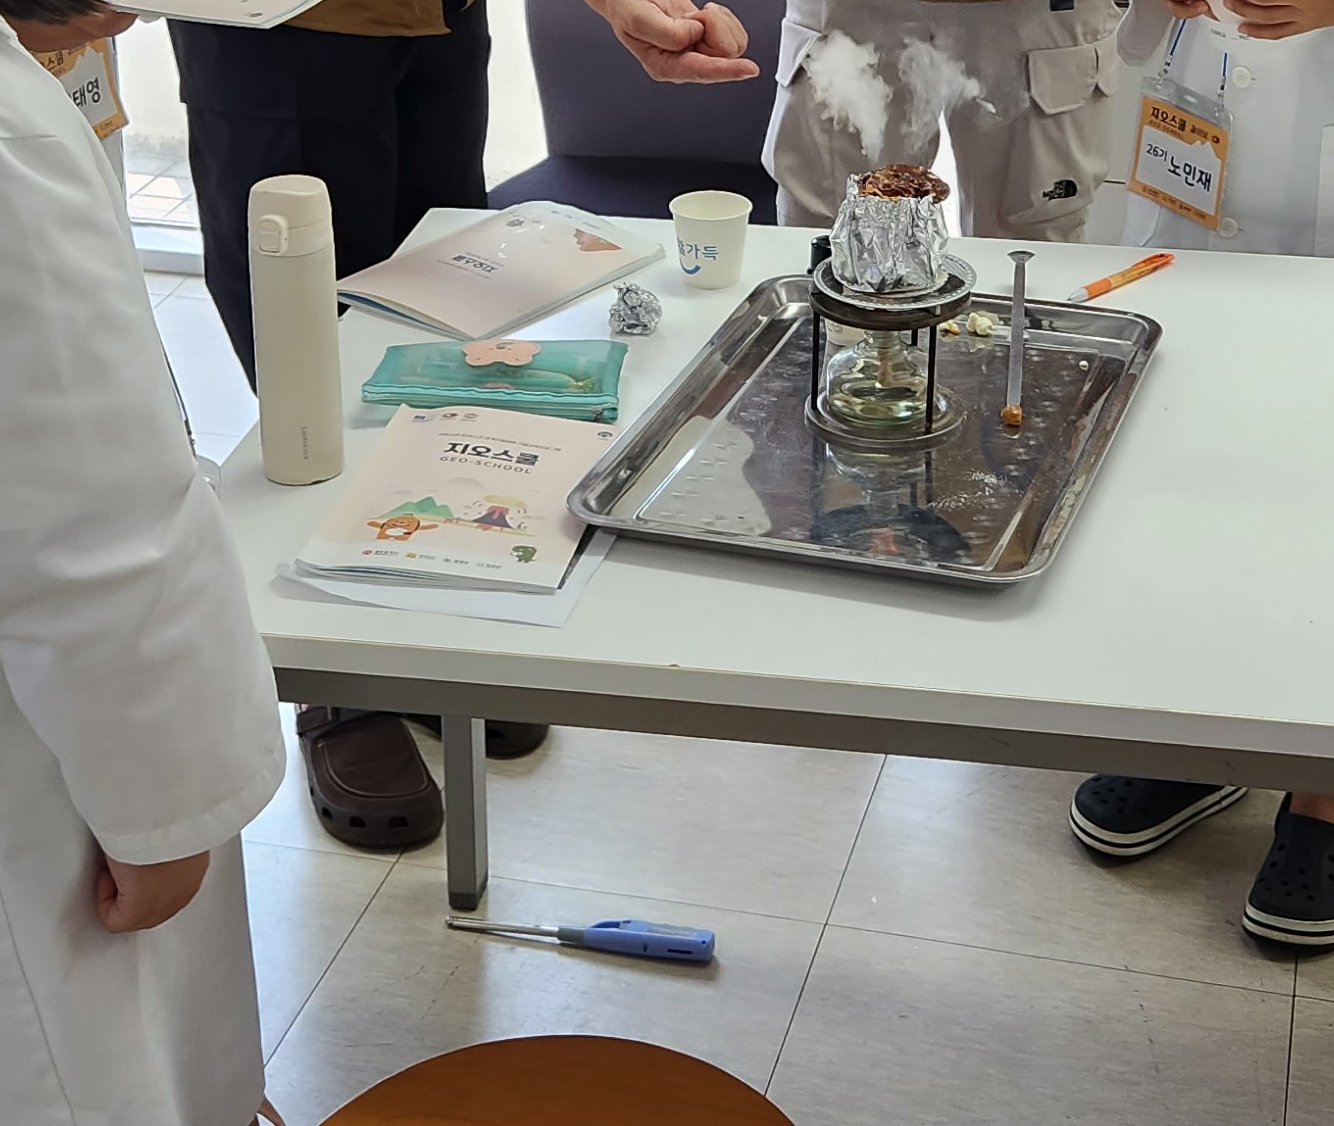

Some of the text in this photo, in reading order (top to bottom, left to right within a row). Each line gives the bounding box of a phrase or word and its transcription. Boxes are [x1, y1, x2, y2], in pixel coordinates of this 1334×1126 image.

[67, 76, 101, 107] 태영
[1150, 106, 1186, 132] 지오스쿨
[1147, 143, 1212, 192] 26기 노민재
[439, 455, 532, 474] GEO-SCHOOL
[443, 442, 540, 466] 지오스쿨
